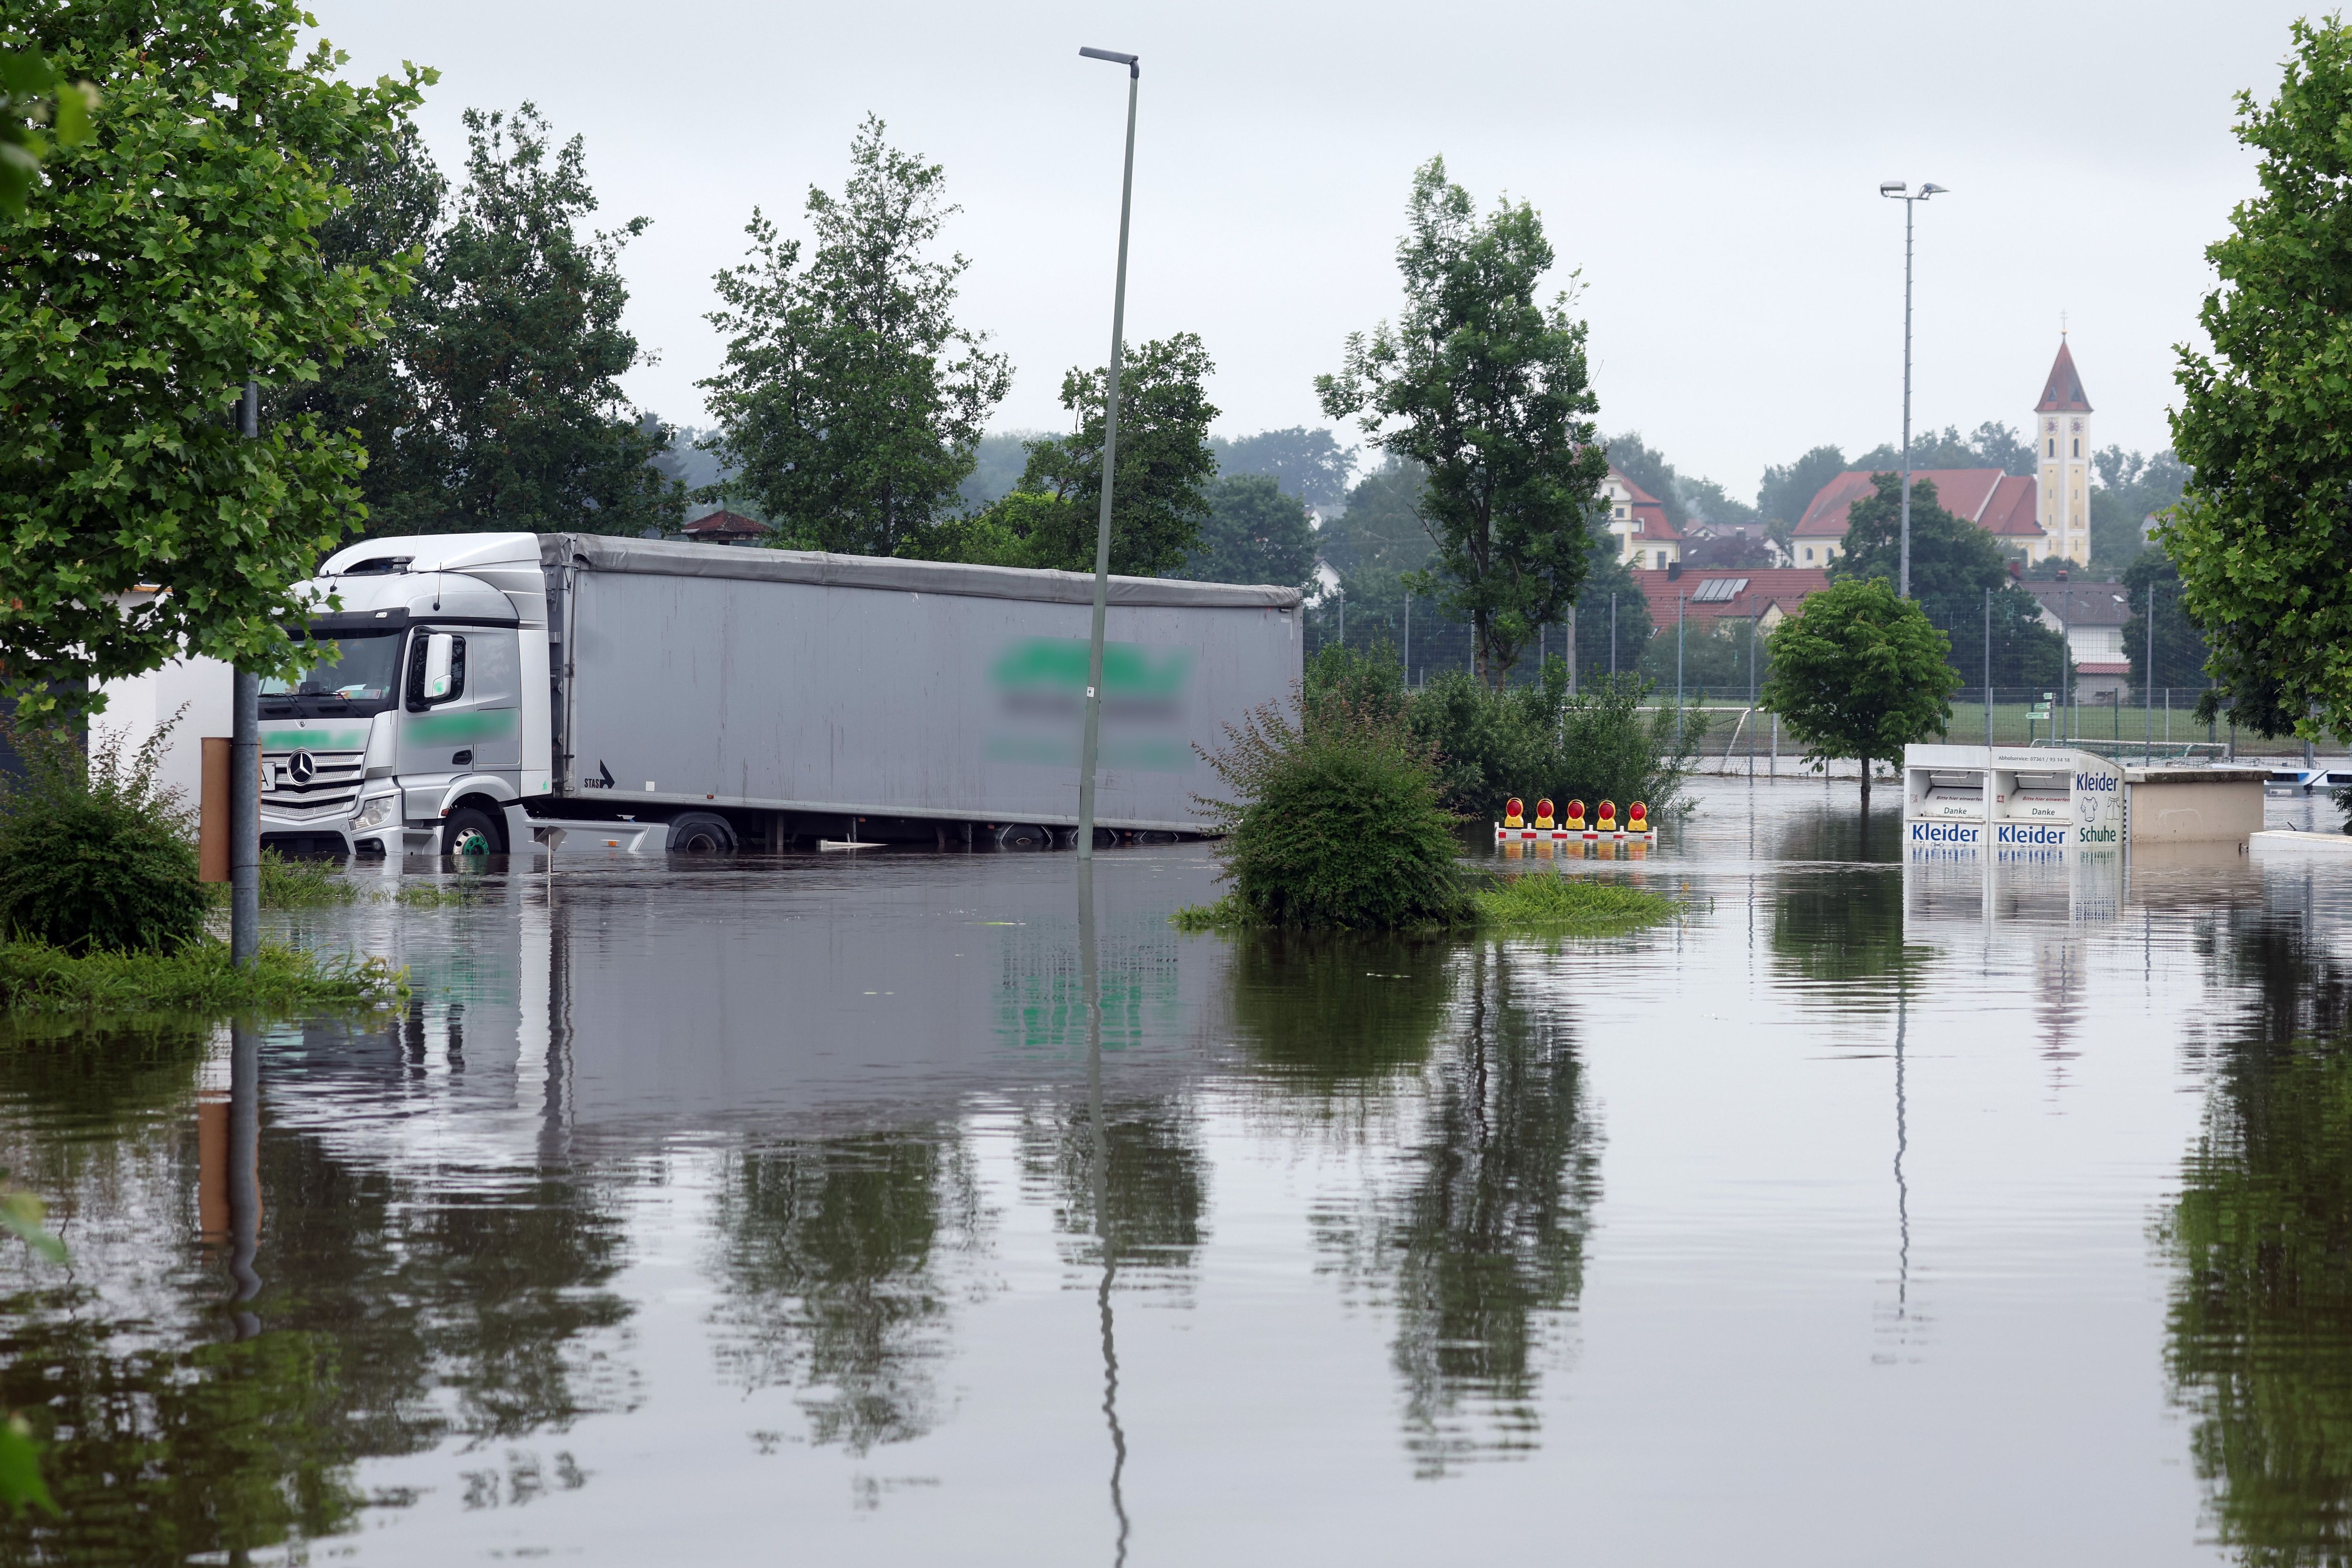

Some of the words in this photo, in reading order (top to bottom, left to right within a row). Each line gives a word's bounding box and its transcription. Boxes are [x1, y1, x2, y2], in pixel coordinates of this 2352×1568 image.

[584, 778, 599, 788] STAS
[2077, 772, 2119, 791] Kleider
[1913, 823, 1979, 842] Kleider
[1999, 825, 2066, 844] Kleider
[2080, 825, 2116, 842] Schuhe
